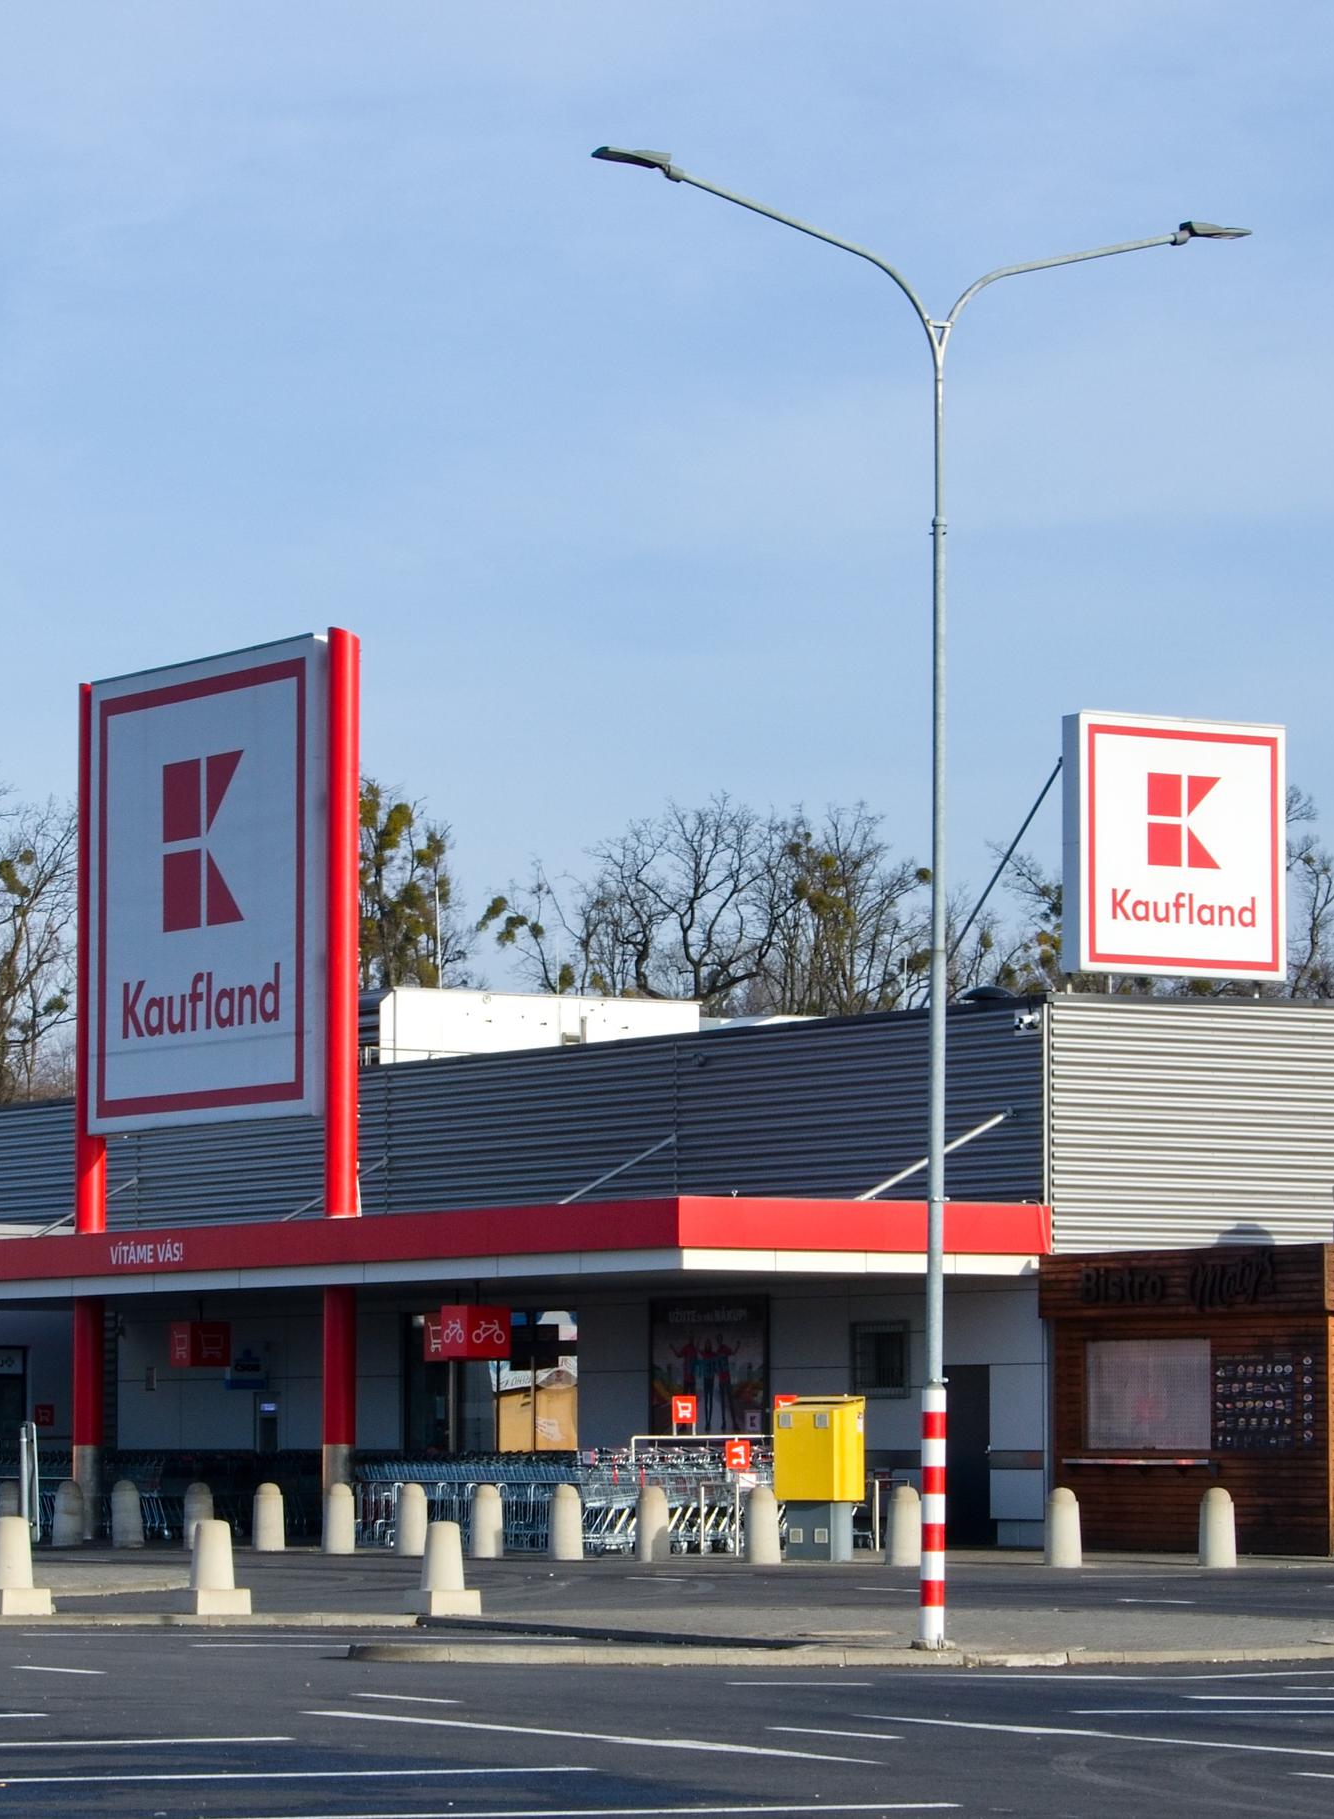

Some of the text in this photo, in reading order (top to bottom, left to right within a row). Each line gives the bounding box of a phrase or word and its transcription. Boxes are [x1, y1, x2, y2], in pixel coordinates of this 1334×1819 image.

[1111, 888, 1257, 928] Kaufland
[122, 962, 280, 1040] Kaufland
[110, 1238, 183, 1265] VÍTÁME VÁS!
[1082, 1268, 1165, 1303] Bistro
